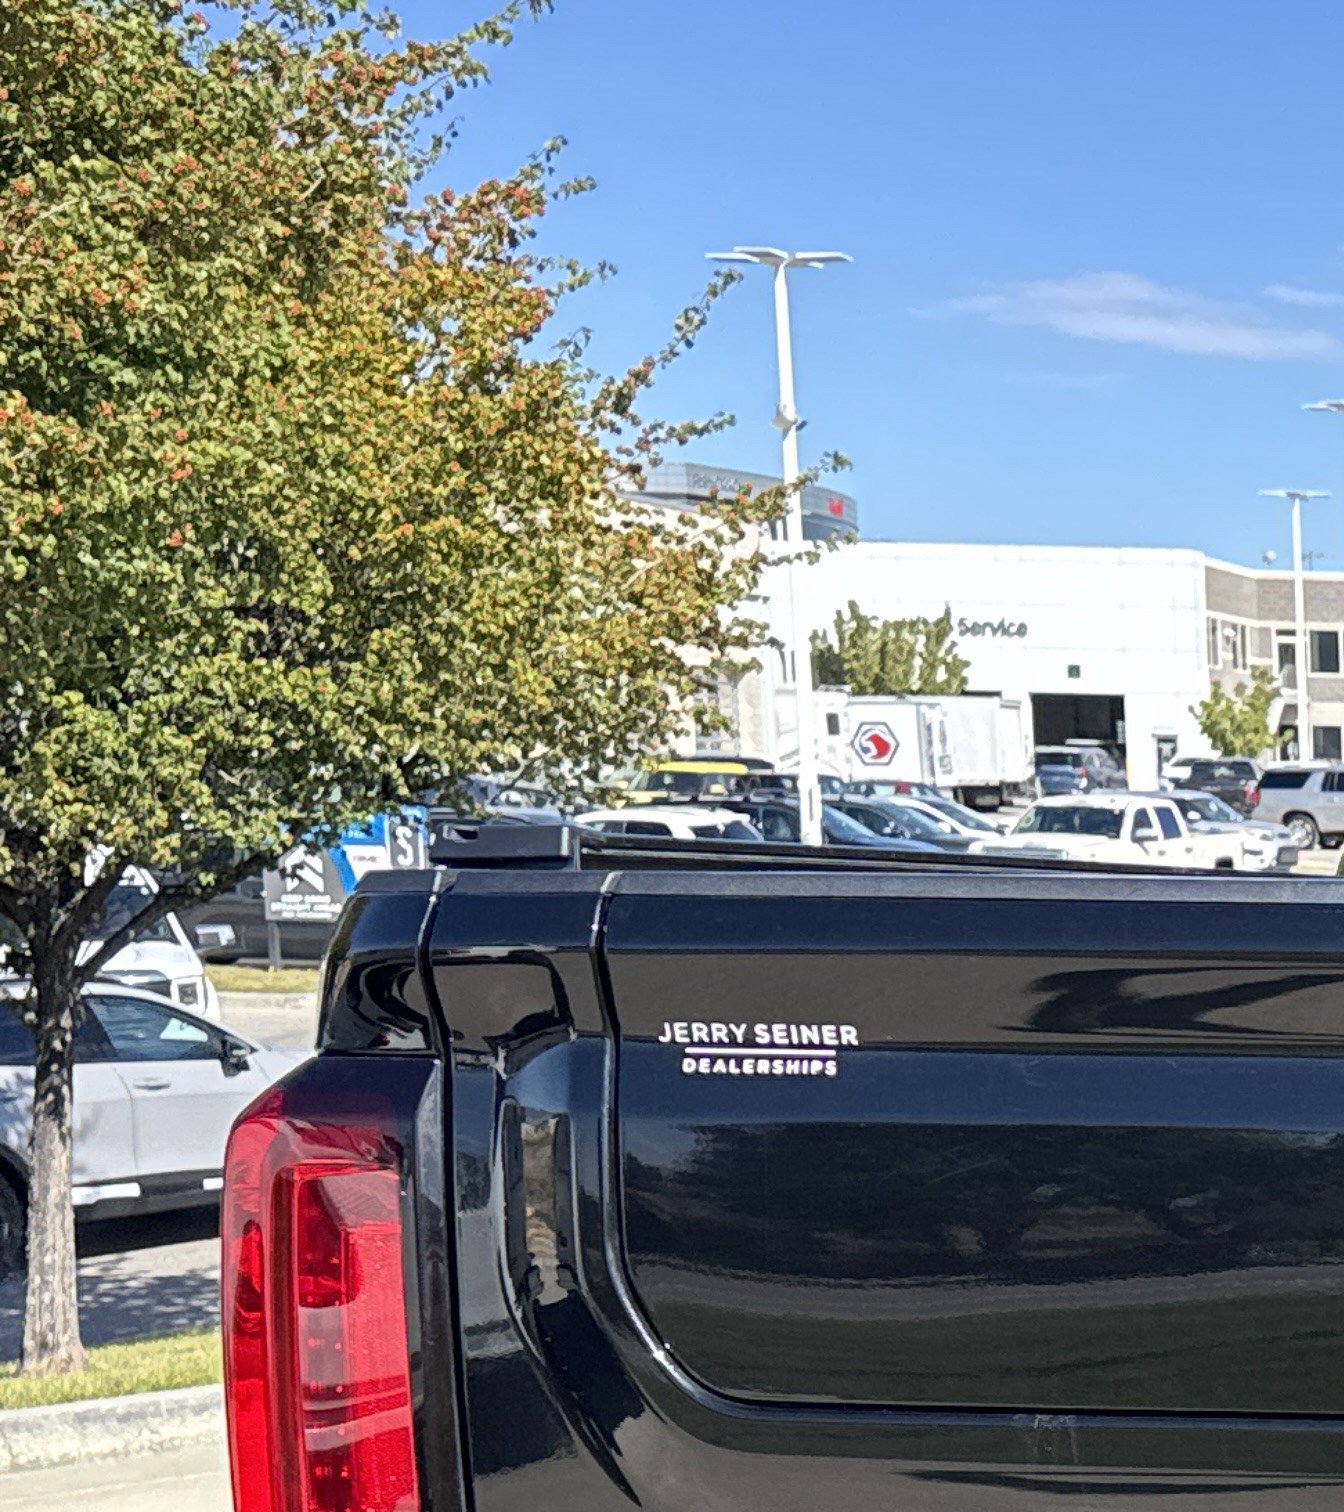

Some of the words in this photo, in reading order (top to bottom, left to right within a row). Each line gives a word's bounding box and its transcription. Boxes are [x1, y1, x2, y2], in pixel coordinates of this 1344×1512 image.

[957, 617, 1028, 638] Service
[658, 1021, 747, 1044] JERRY
[753, 1023, 859, 1046] SEINER
[681, 1057, 838, 1077] DEALERSHIPS
